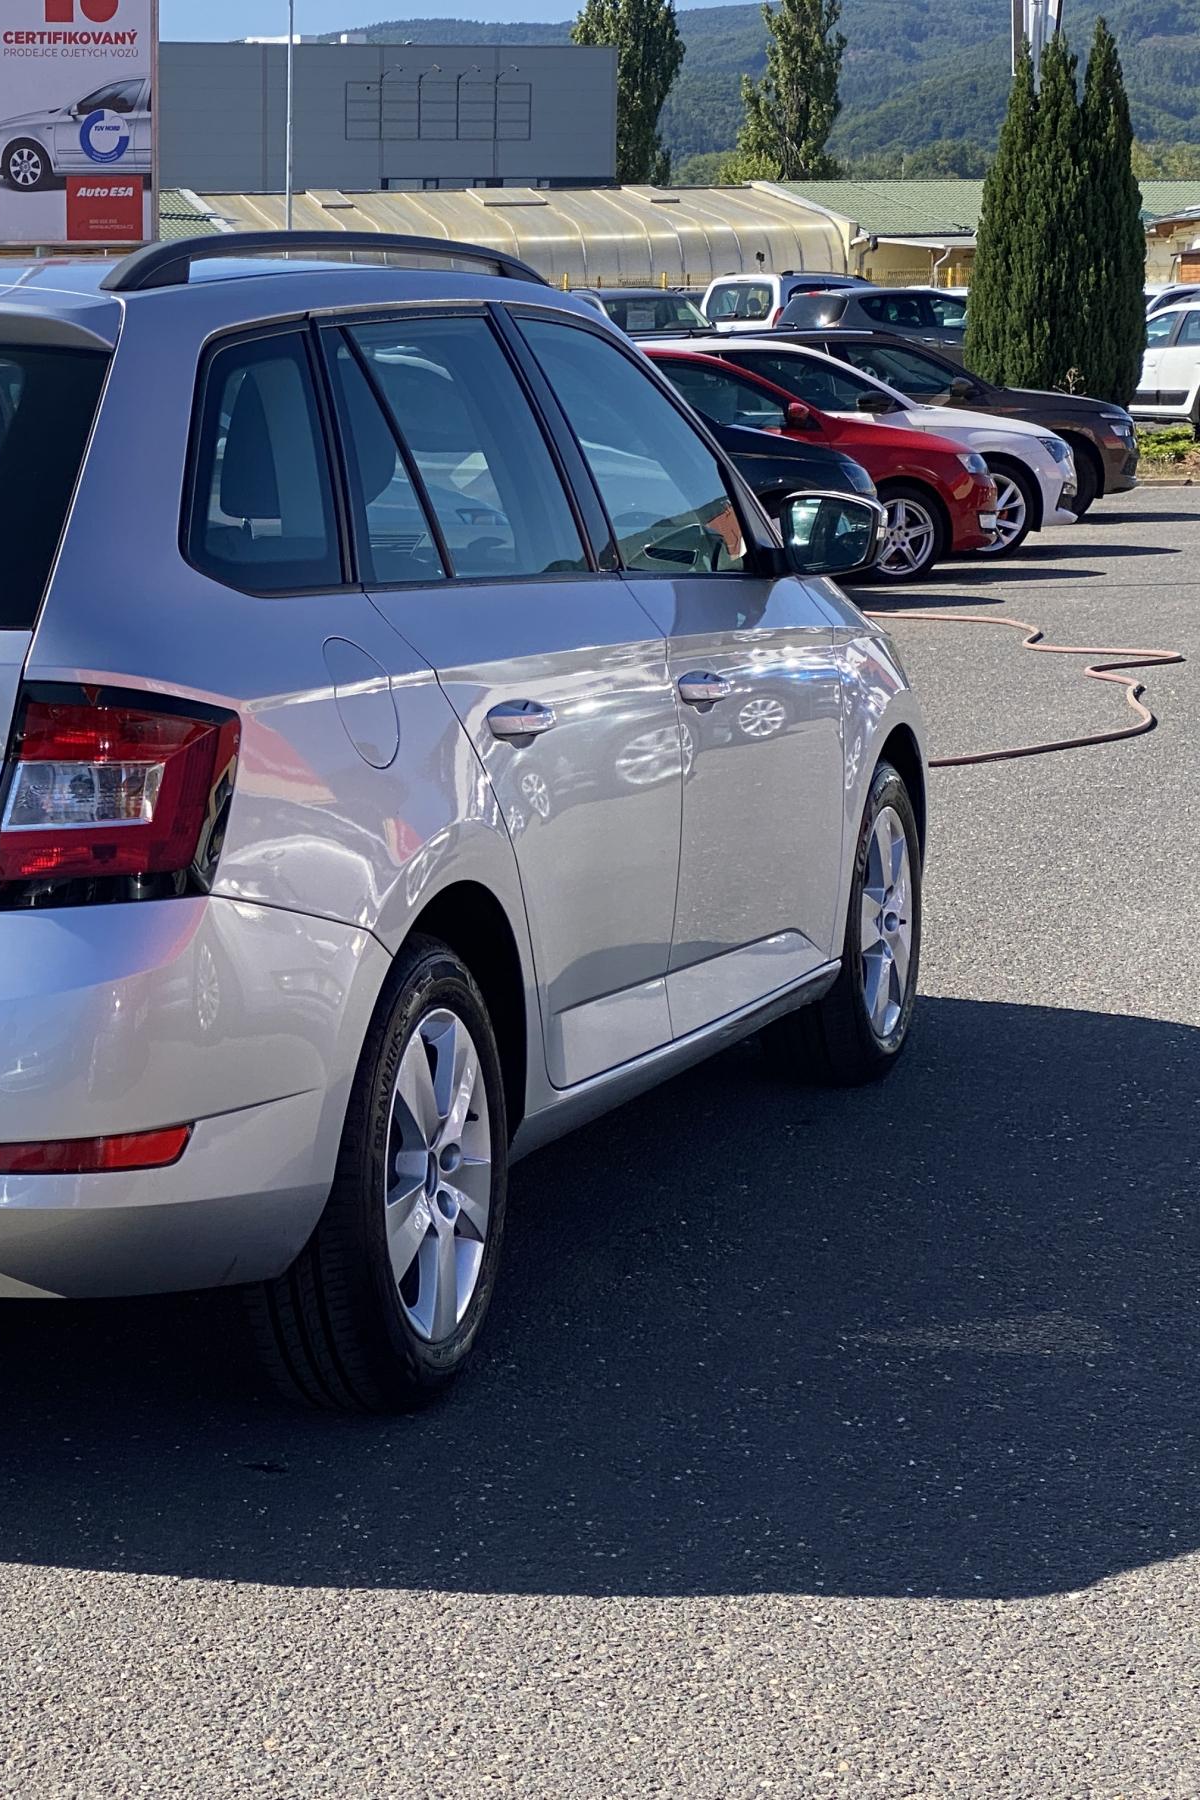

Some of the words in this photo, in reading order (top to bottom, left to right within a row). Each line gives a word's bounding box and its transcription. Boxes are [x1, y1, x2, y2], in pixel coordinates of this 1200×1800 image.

[3, 29, 138, 45] CERTIFIKOVANÝ
[3, 48, 58, 58] PRODEJCE
[61, 48, 107, 58] OJETÝCH
[110, 47, 139, 58] VOZŮ
[77, 187, 108, 197] Auto
[109, 187, 134, 197] ESA
